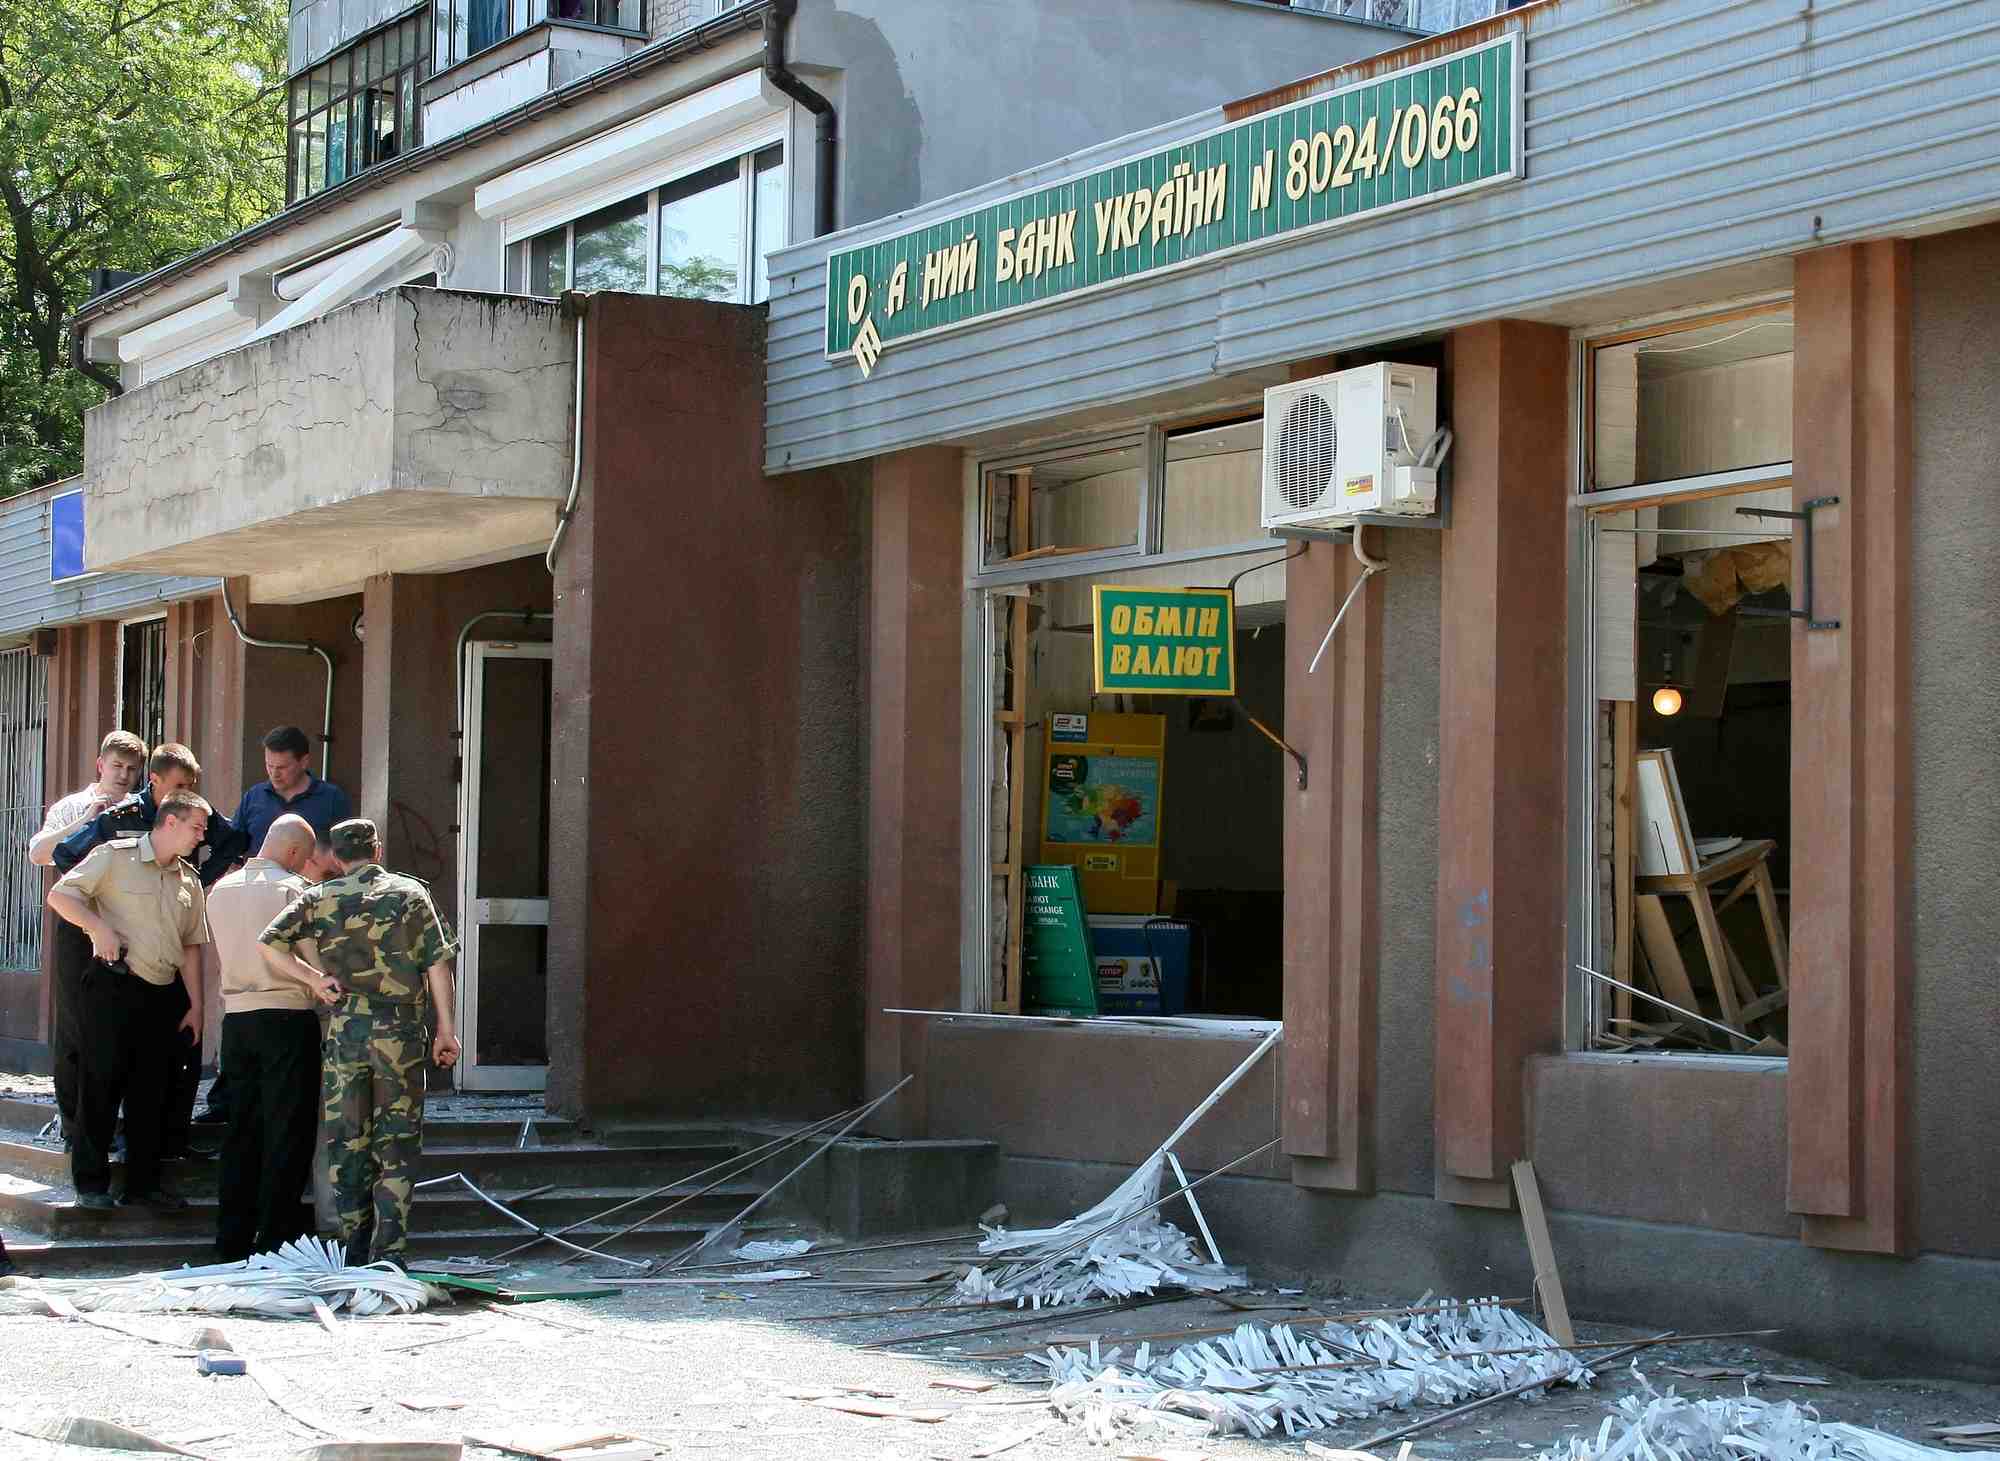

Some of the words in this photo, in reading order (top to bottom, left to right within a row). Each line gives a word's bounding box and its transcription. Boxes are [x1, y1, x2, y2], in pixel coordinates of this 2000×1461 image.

[995, 208, 1077, 284] БАНК
[1093, 162, 1227, 256] УКРАЇНИ
[1285, 86, 1481, 201] 8024/066
[1110, 604, 1220, 637] ОБМІН
[1110, 644, 1221, 676] ВАЛЮТ
